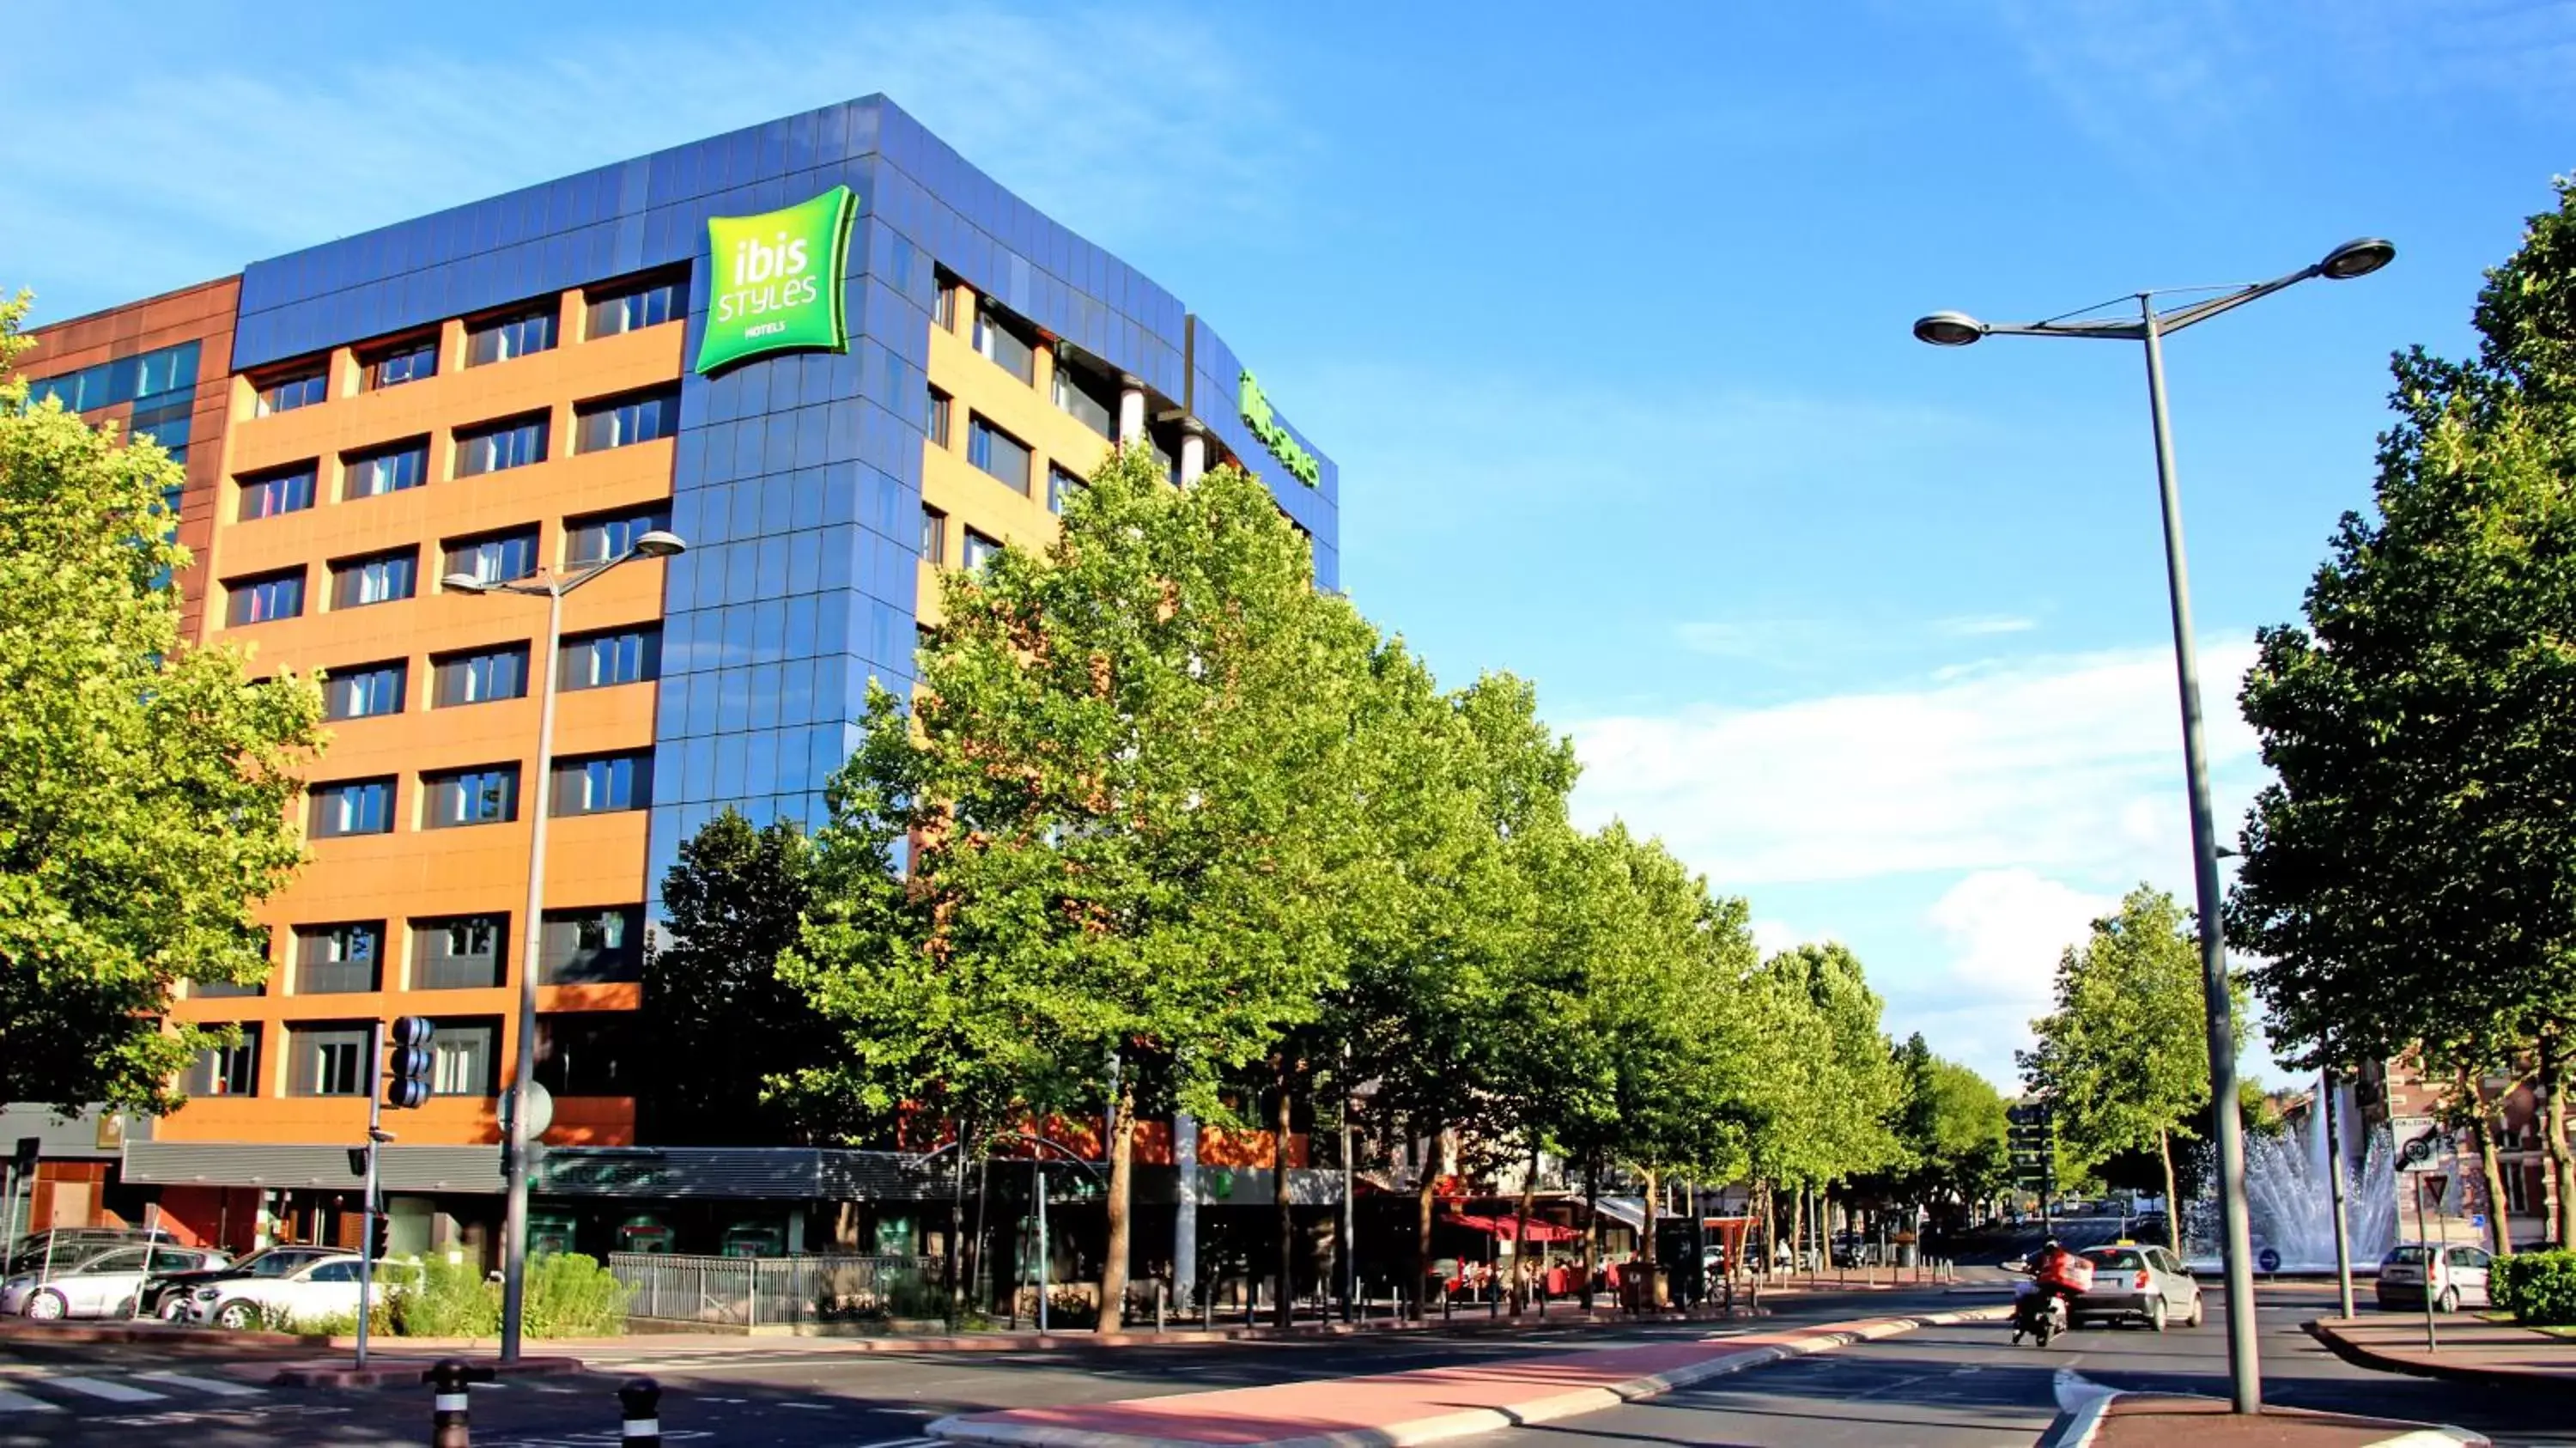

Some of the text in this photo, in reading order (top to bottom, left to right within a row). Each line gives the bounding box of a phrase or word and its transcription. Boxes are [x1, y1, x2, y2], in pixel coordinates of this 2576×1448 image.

[735, 232, 808, 286] ibis
[744, 320, 787, 340] HOTELS
[2408, 1144, 2424, 1157] 30
